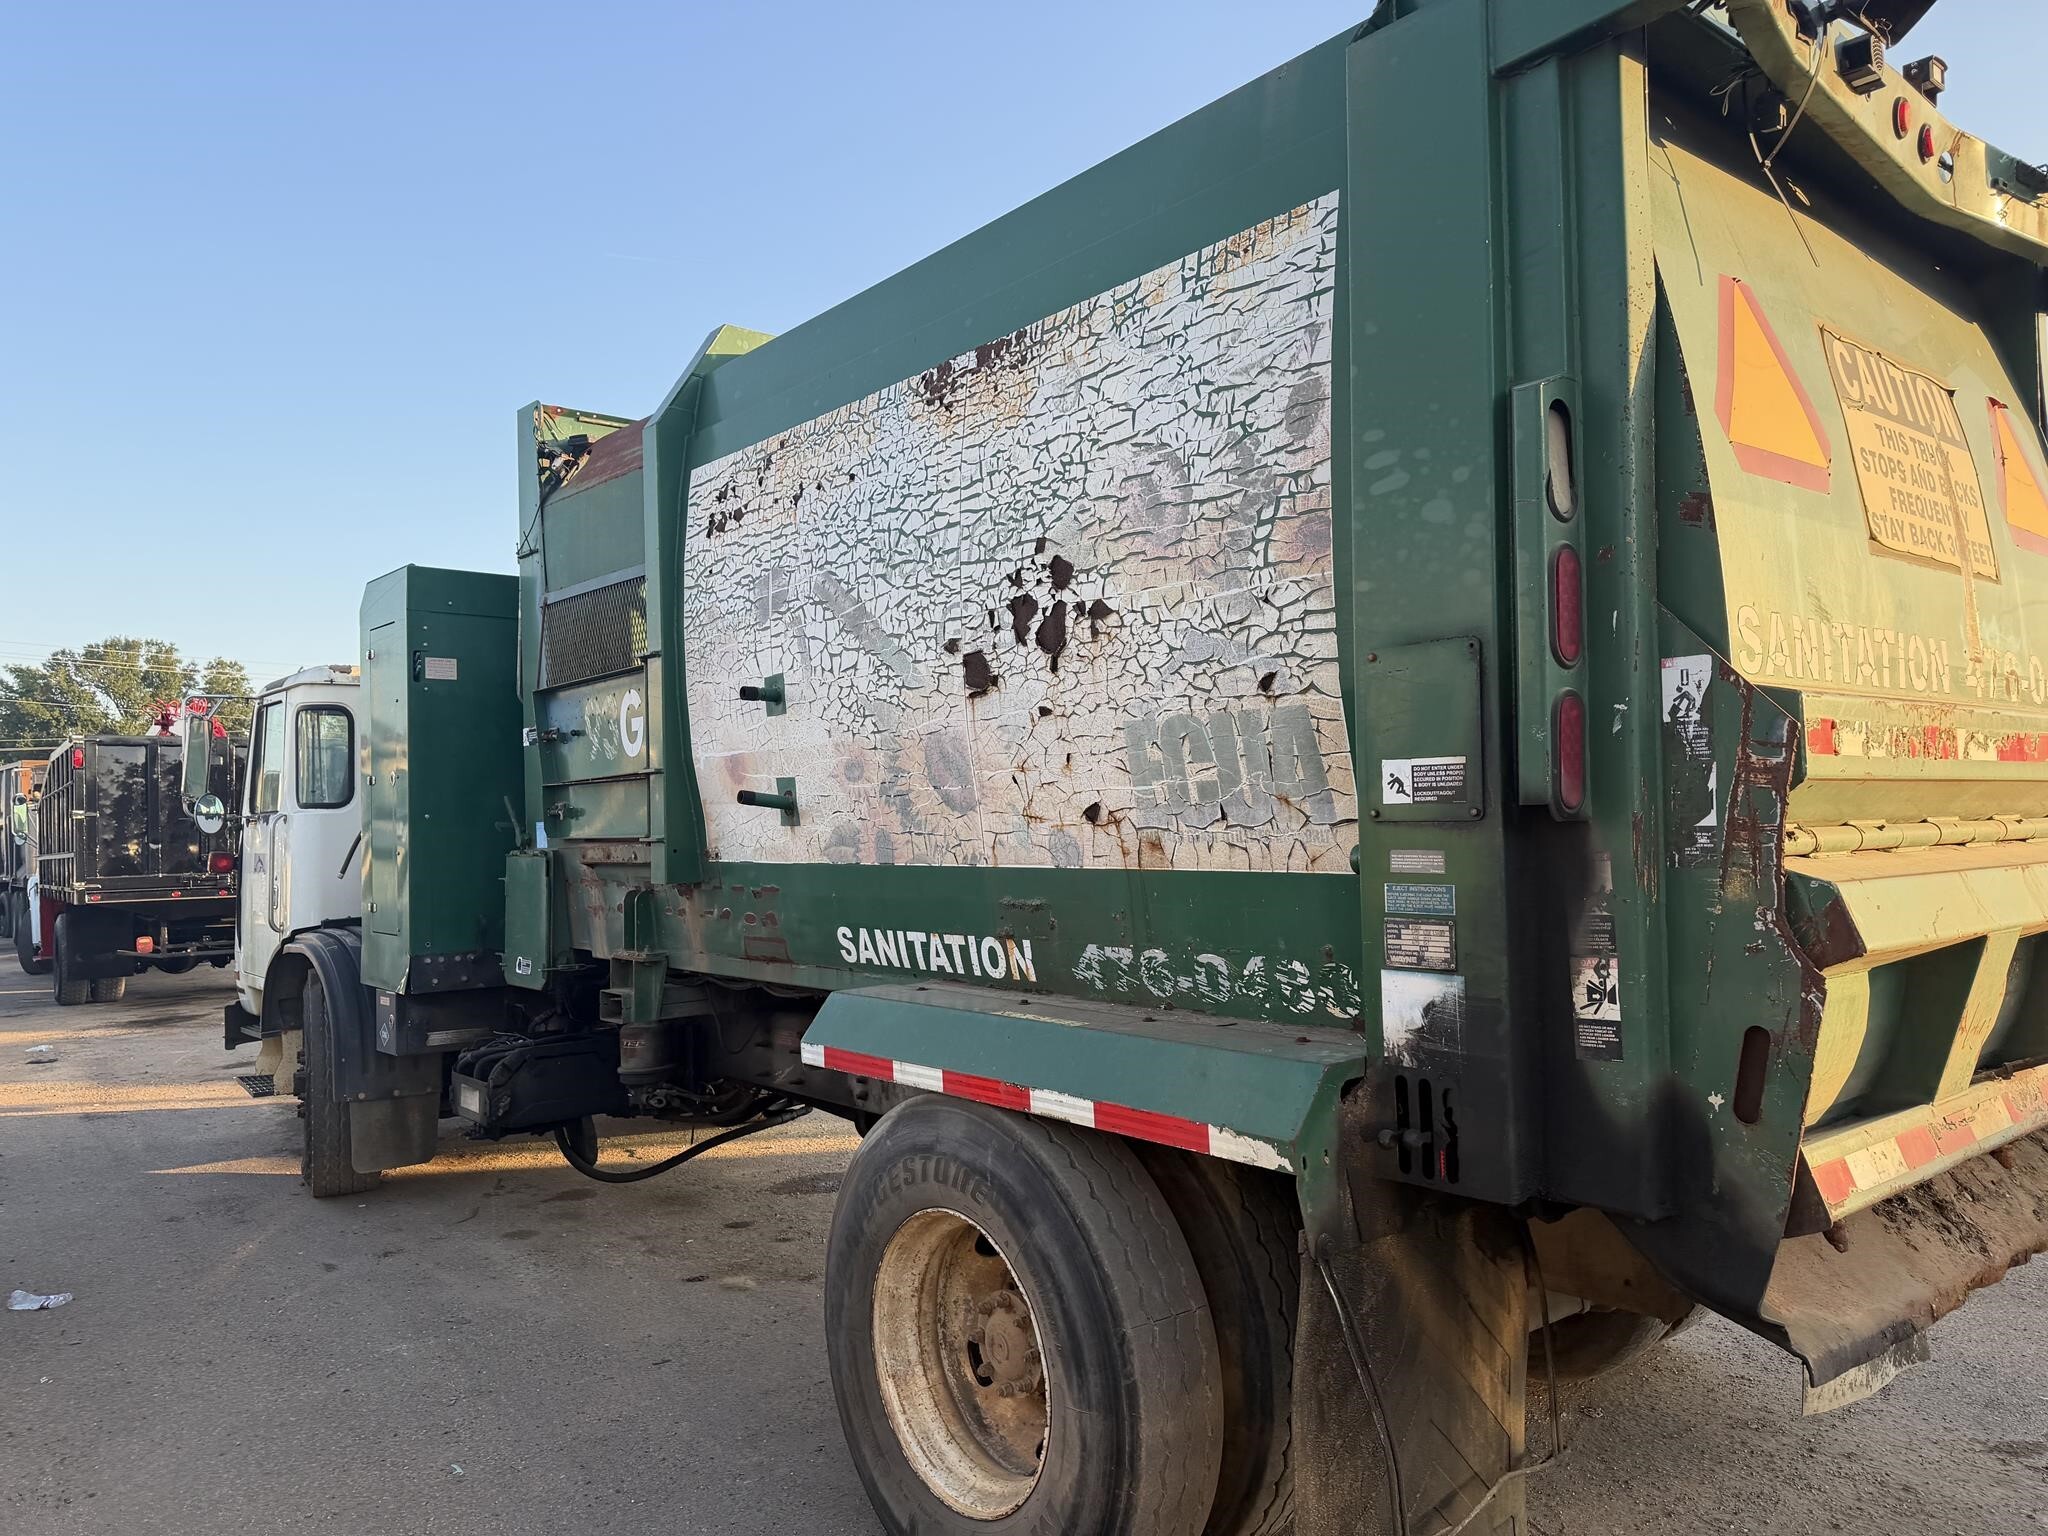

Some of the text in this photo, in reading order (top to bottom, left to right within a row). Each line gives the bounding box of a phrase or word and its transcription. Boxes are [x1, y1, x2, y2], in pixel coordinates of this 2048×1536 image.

[1833, 339, 1961, 441] CAUTION
[1860, 446, 1906, 482] STOPS
[1910, 463, 1937, 492] AND
[1873, 423, 1955, 473] THIS TRUCK
[1872, 514, 1908, 545] STAY
[1909, 524, 1946, 555] BACK
[1889, 486, 1969, 533] FREQUENY
[1737, 604, 2048, 705] SANITATION 476-0
[836, 926, 1037, 982] SANITATION
